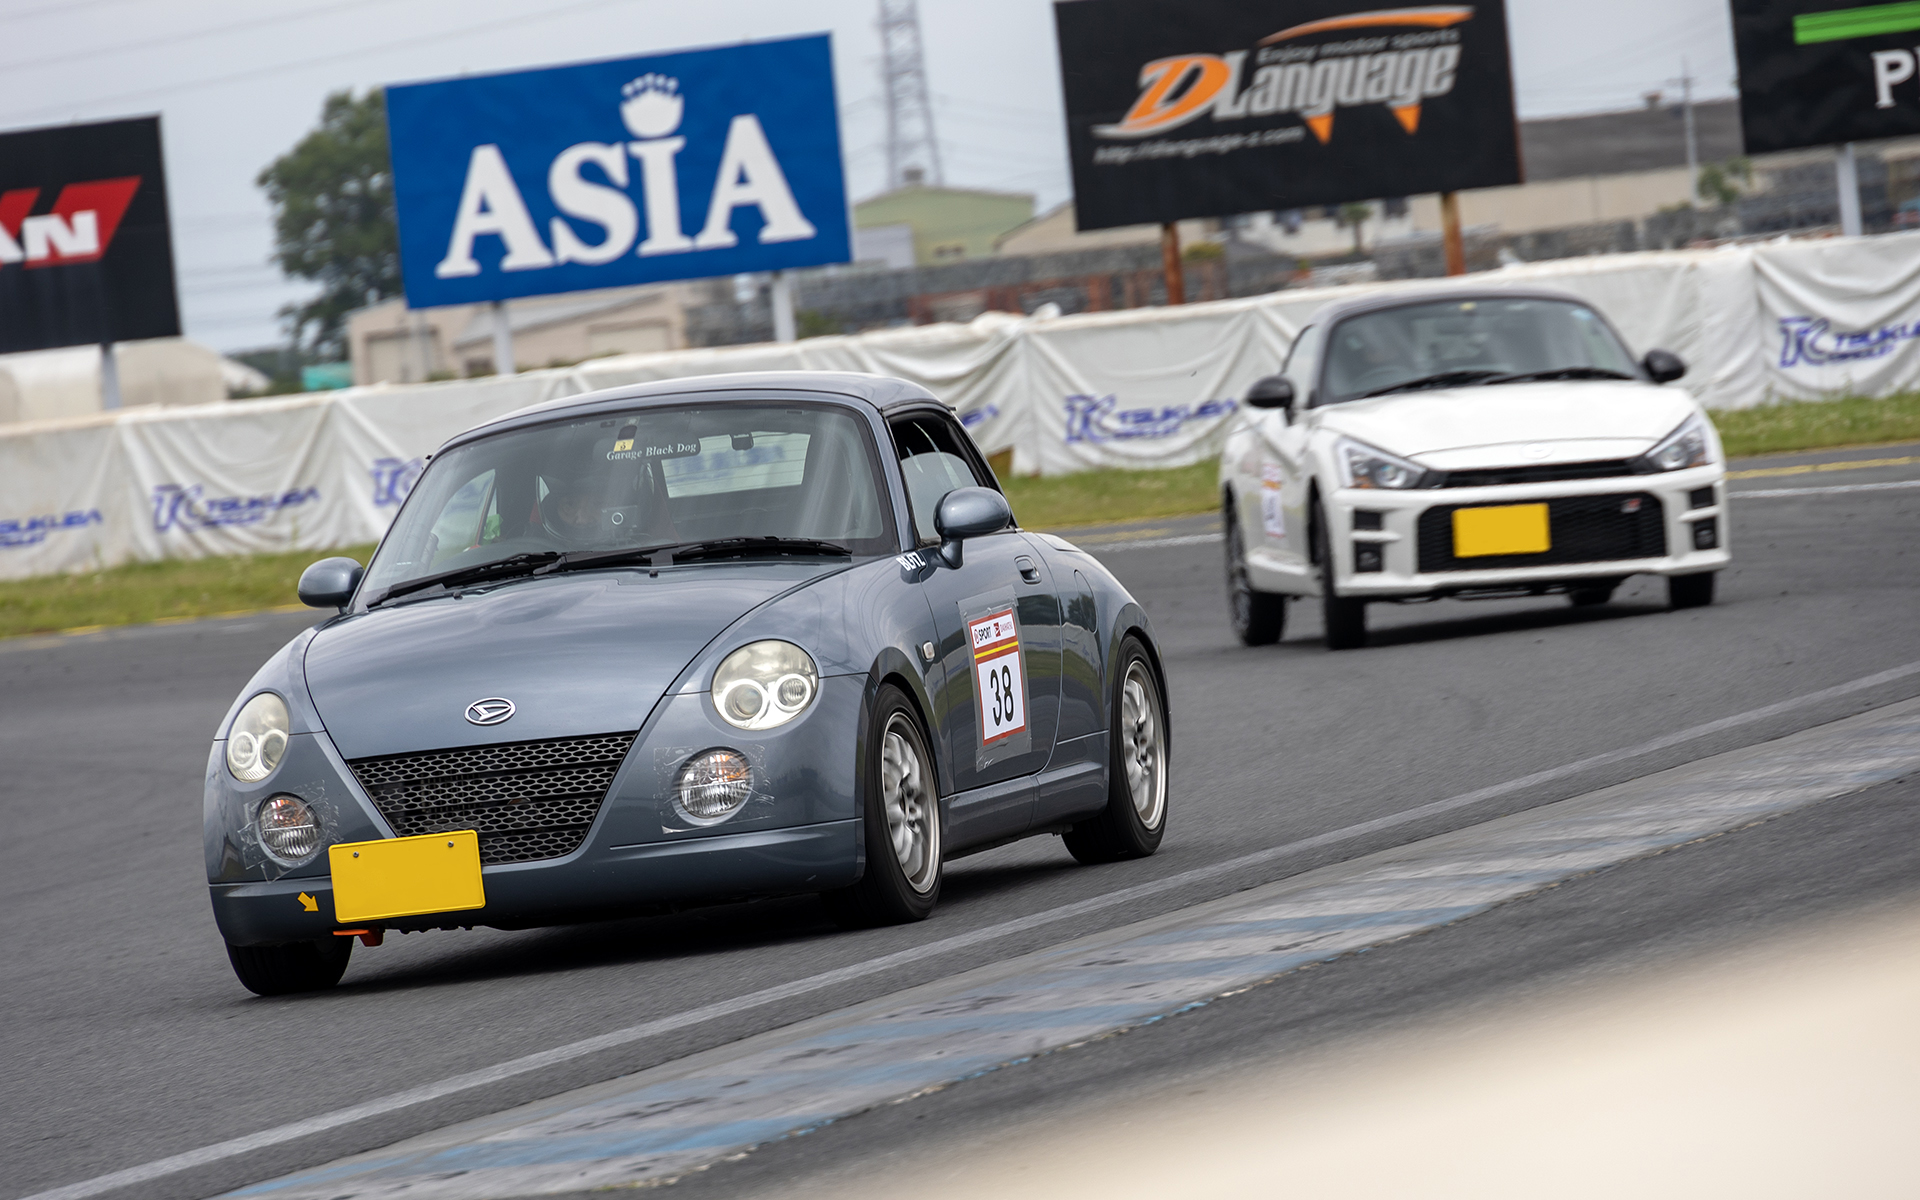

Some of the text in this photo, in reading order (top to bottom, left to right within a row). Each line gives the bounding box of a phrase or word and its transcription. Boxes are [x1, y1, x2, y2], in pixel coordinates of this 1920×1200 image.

[1869, 44, 1920, 110] P
[435, 113, 817, 279] ASIA
[606, 442, 697, 461] Garage Black Dog
[990, 665, 1014, 726] 38
